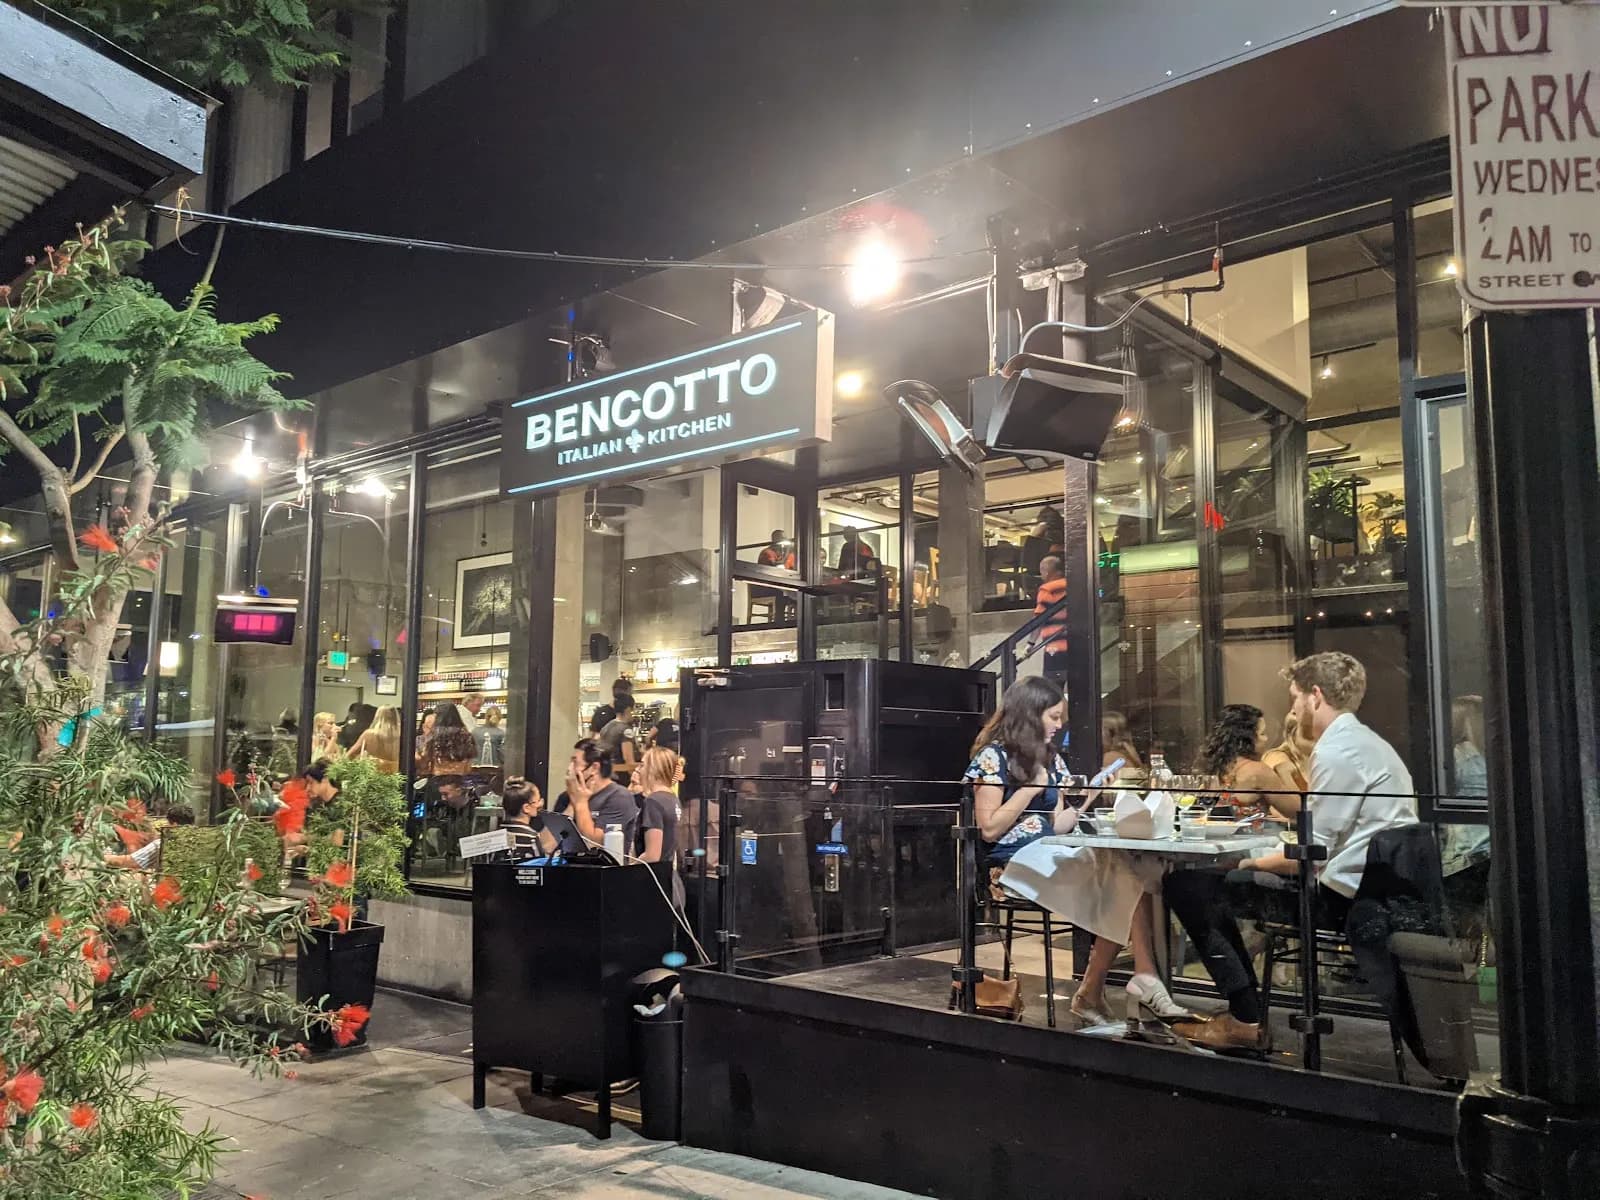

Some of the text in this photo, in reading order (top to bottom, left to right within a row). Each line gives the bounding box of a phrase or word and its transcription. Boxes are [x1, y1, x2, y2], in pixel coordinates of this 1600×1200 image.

[1474, 157, 1600, 195] WEDNE
[1569, 232, 1592, 254] TO
[1479, 273, 1565, 288] STREET
[525, 353, 777, 450] BENCOTTO
[557, 413, 731, 465] ITALIAN KITCHEN
